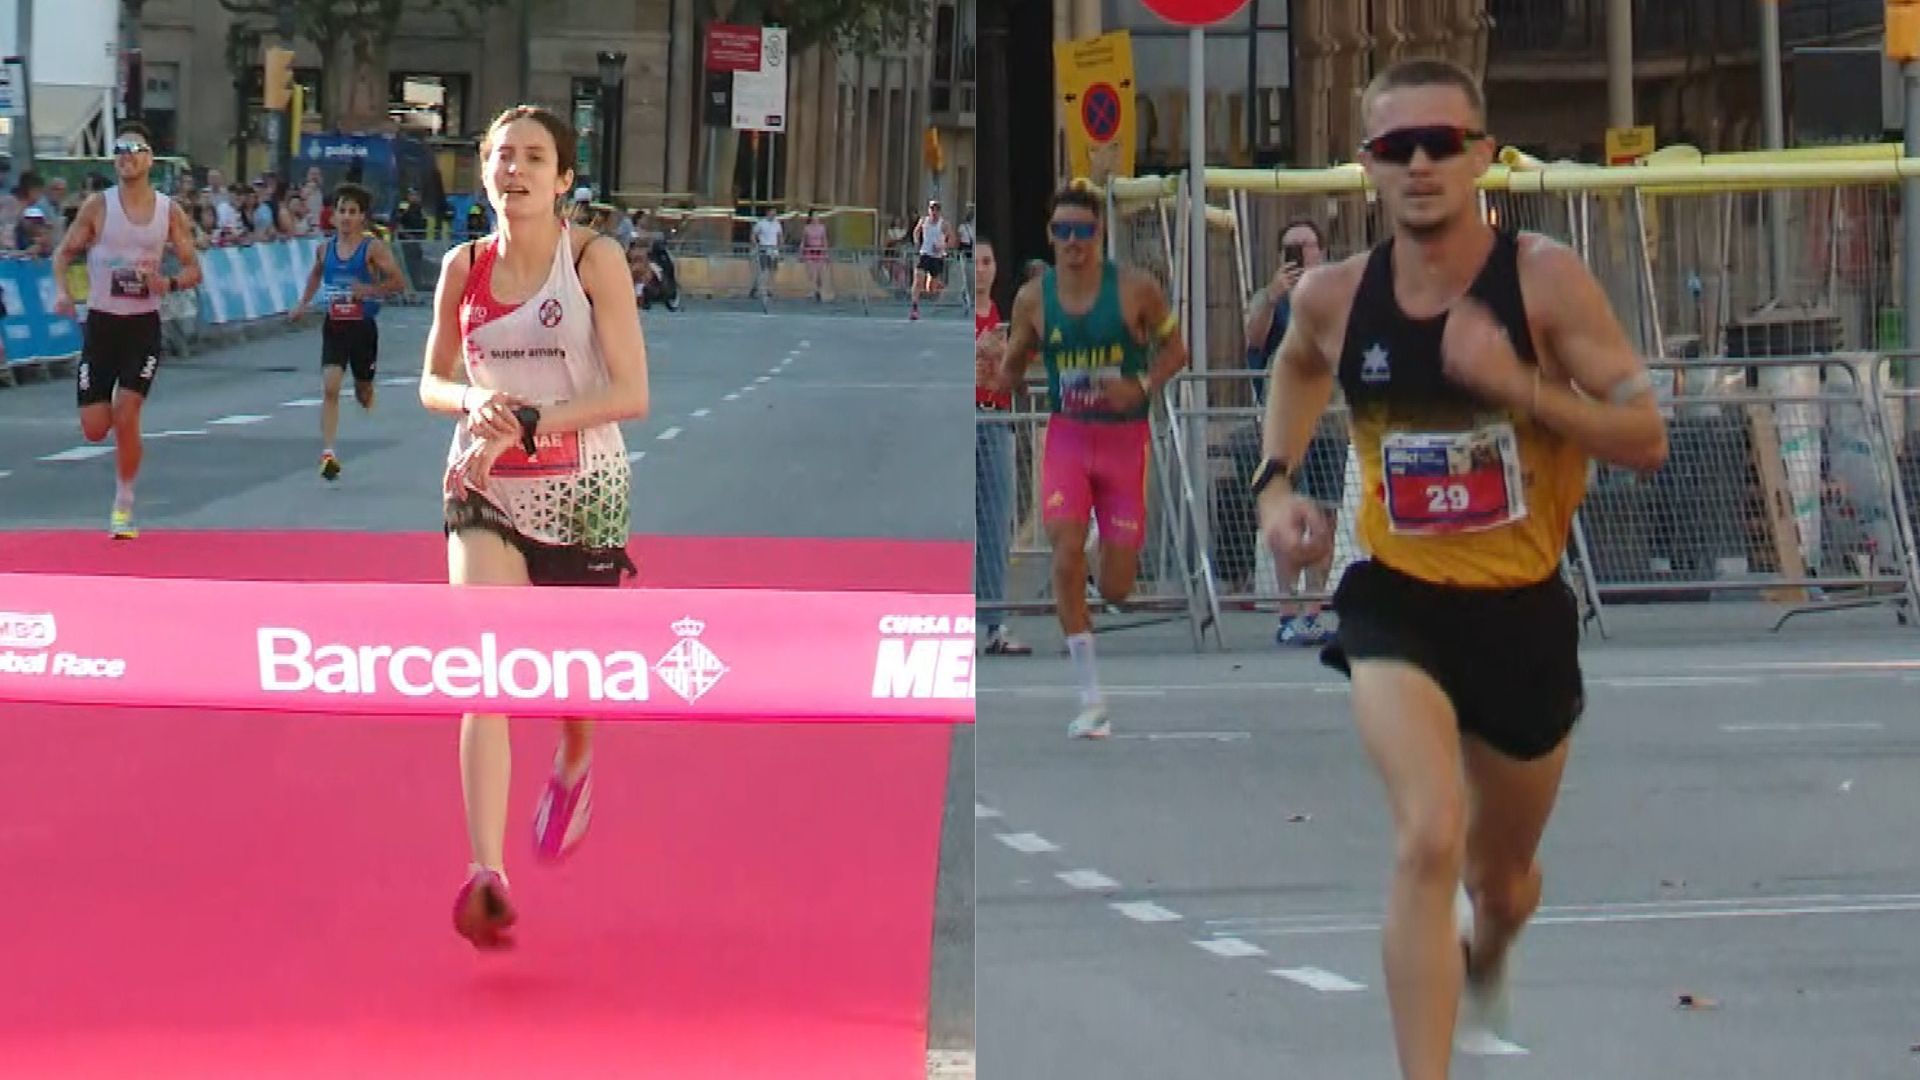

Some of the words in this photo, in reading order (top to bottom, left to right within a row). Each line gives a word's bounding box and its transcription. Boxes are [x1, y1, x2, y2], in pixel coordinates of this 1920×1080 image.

[1426, 484, 1470, 513] 29
[878, 615, 950, 634] CURSA
[52, 653, 126, 678] Race
[256, 626, 650, 701] Barcelona
[871, 639, 976, 699] ME
